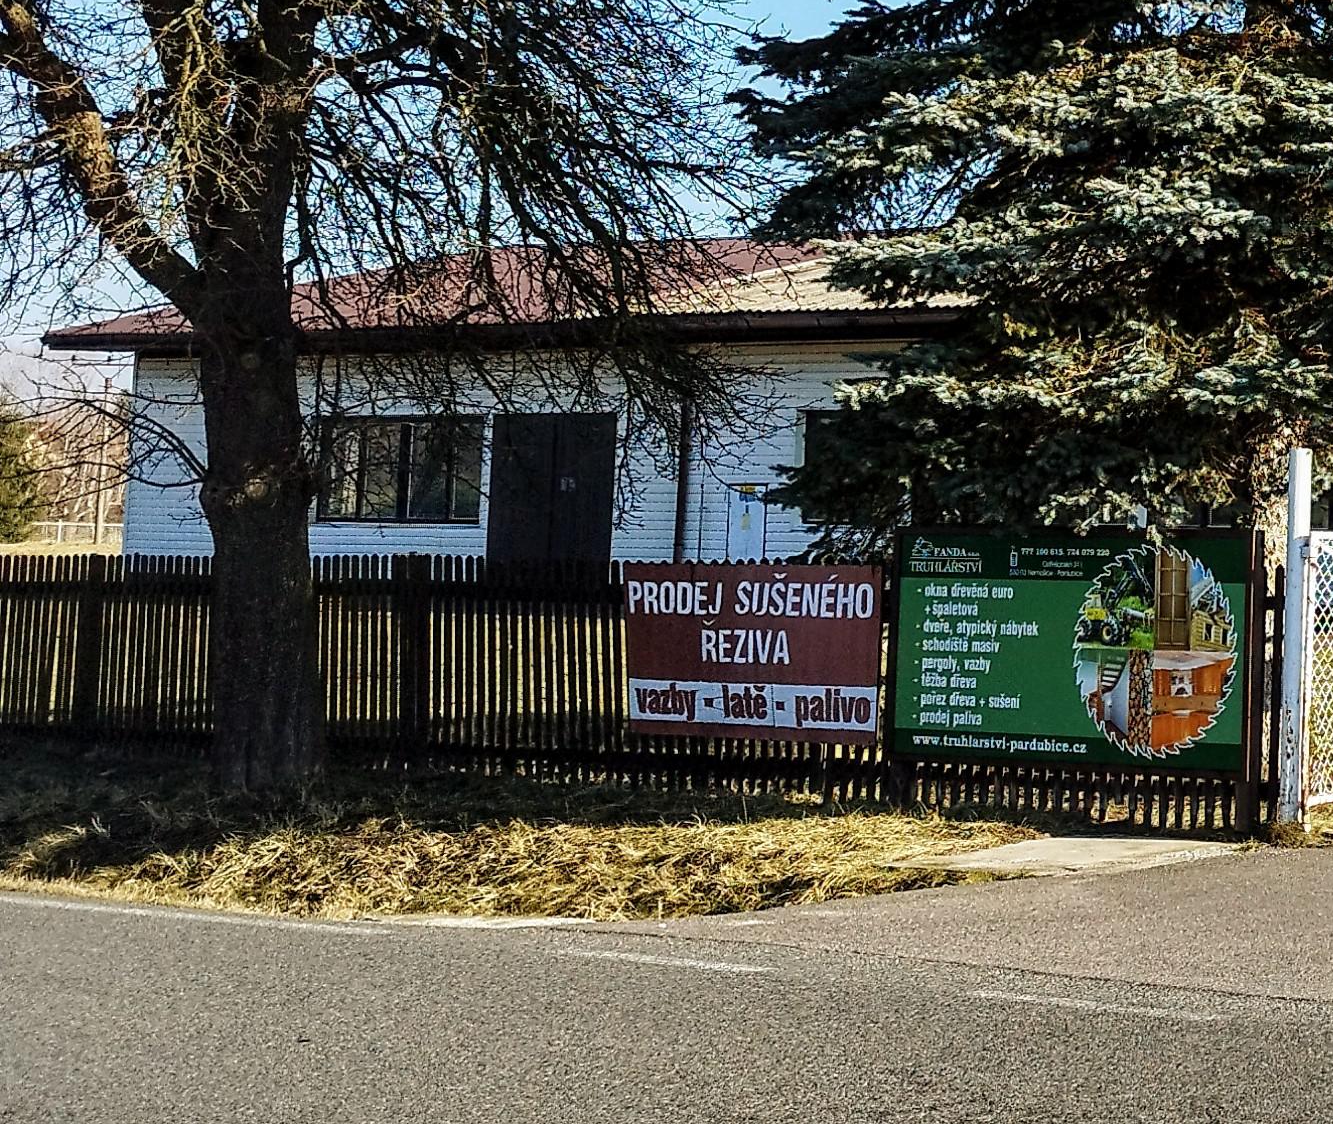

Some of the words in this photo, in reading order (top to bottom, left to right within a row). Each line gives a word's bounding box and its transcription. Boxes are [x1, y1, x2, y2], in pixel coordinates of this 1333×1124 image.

[934, 547, 967, 557] FANDA
[1021, 547, 1034, 556] 777
[909, 559, 982, 574] TRUHLÁŘSTVÍ
[627, 580, 723, 615] PRODEJ
[734, 572, 875, 619] SUŠENÉHO
[924, 583, 948, 597] okna
[951, 583, 989, 598] dřevěná
[991, 587, 1014, 599] euro
[923, 619, 952, 635] dveře,
[956, 621, 997, 637] atypický
[1000, 621, 1039, 638] nábytek
[700, 619, 791, 665] ŘEZIVA
[922, 637, 969, 652] schodiště
[921, 655, 960, 672] pergoly,
[964, 656, 991, 674] vazby
[921, 672, 947, 688] těžba
[950, 674, 977, 689] dřeva
[635, 682, 698, 722] vazby
[721, 684, 768, 720] latě
[795, 688, 871, 727] palivo
[920, 691, 947, 707] pořez
[950, 692, 976, 707] dřeva
[988, 693, 1020, 709] sušení
[919, 709, 950, 726] prodej
[952, 710, 982, 727] paliva
[912, 733, 1088, 754] www.truhlarstvi-pardubice.cz
